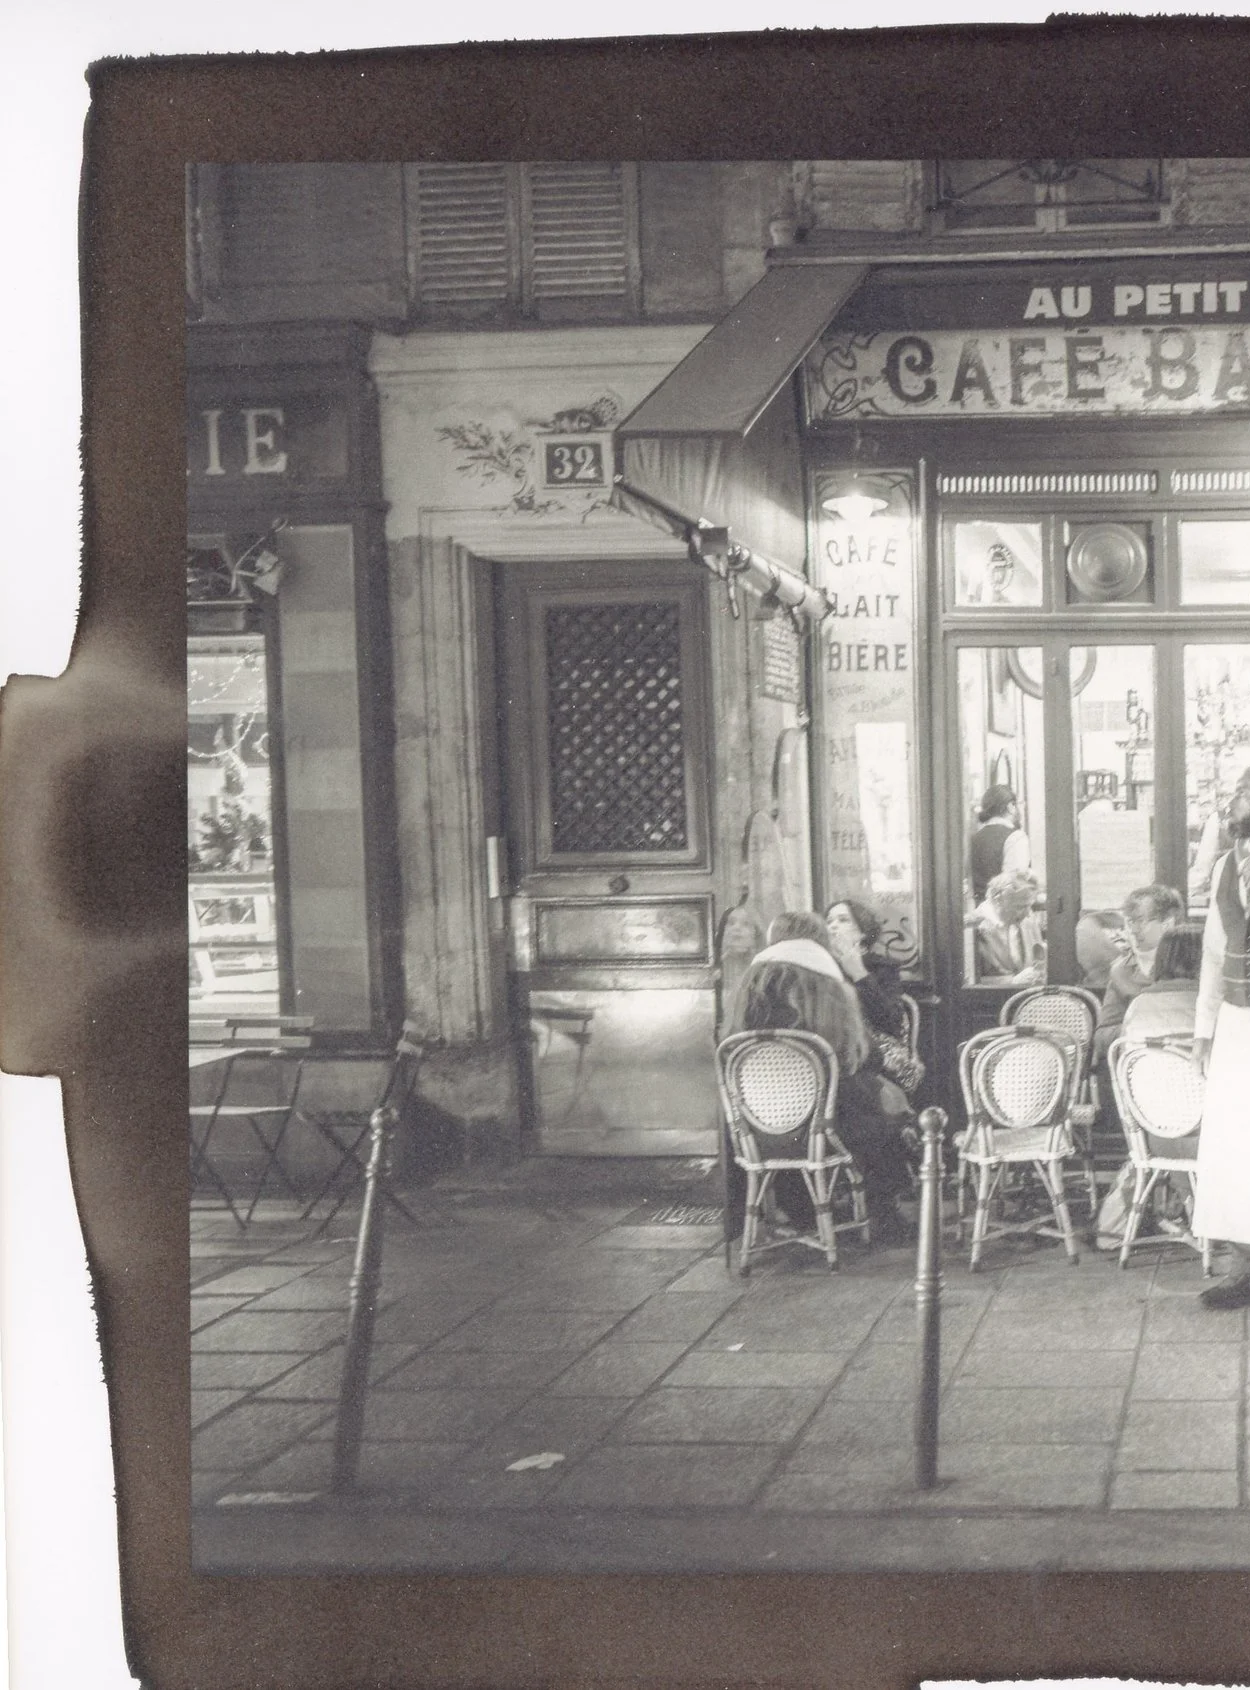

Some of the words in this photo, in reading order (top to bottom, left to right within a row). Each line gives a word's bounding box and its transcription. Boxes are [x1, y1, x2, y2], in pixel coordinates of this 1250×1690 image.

[1024, 285, 1093, 320] AU
[1114, 281, 1249, 317] PETIT
[186, 406, 290, 477] IE
[553, 446, 597, 481] 32
[832, 592, 901, 619] LAIT
